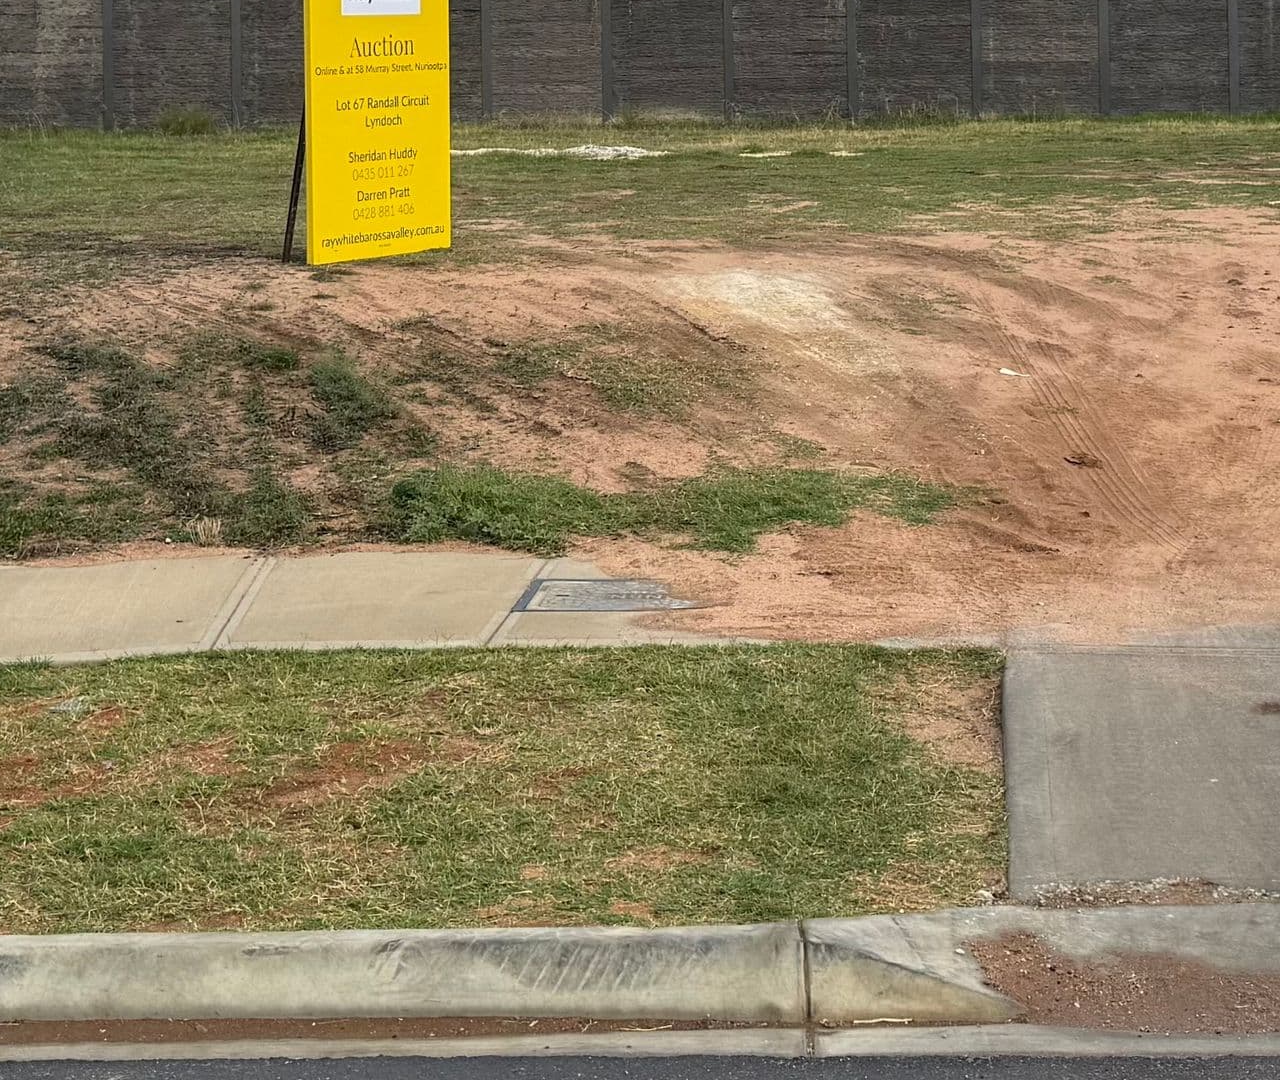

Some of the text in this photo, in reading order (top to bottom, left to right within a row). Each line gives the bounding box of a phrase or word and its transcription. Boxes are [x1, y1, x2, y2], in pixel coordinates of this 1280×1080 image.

[350, 34, 415, 58] Auction
[315, 65, 338, 76] Online
[339, 65, 345, 75] &
[346, 66, 353, 74] at
[355, 64, 364, 74] 58
[365, 64, 390, 74] Murray
[336, 94, 429, 111] Lot 67 Randall Circuit
[365, 114, 402, 129] Lyndoch
[348, 147, 418, 164] Sheridan Huddy
[352, 164, 415, 181] 0435 011 267
[357, 186, 410, 202] Darren Pratt
[353, 203, 415, 220] 0428 881 406
[322, 223, 445, 248] raywhitebarossavalley.com.au
